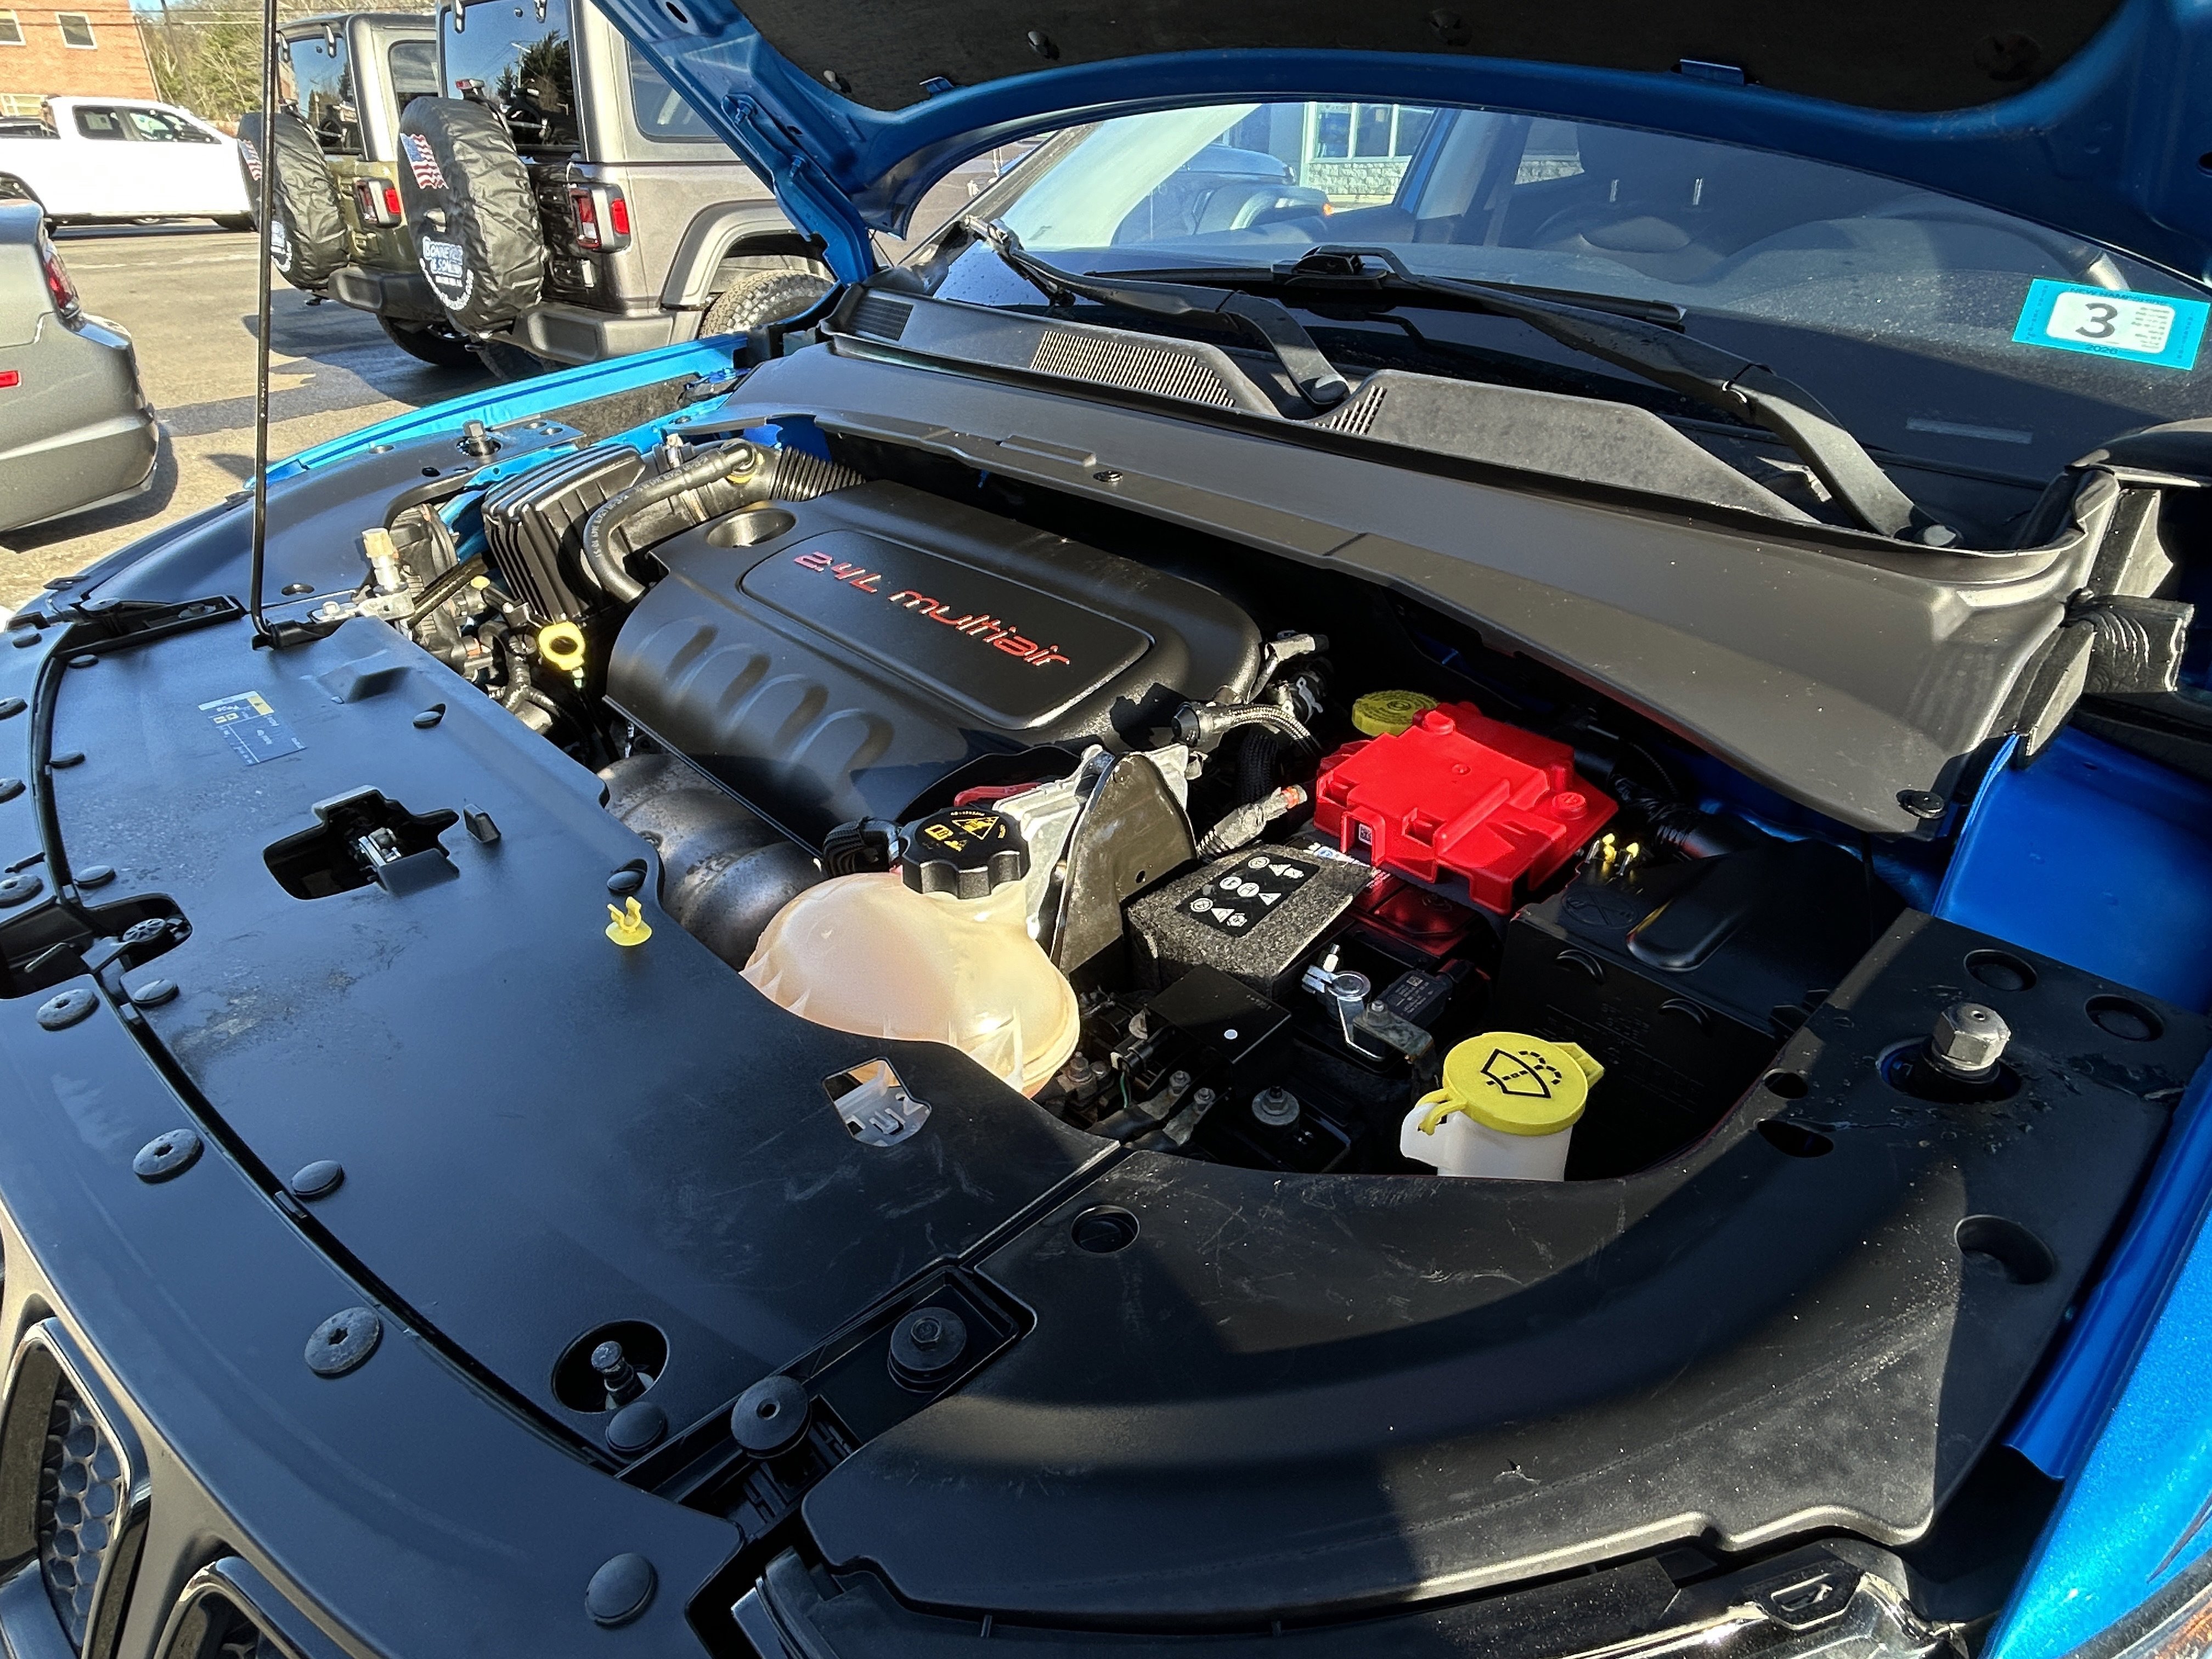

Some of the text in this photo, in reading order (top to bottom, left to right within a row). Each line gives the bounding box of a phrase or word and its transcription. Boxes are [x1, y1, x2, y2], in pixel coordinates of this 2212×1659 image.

[2075, 302, 2118, 338] 3
[793, 551, 1070, 666] 2.4L multiair
